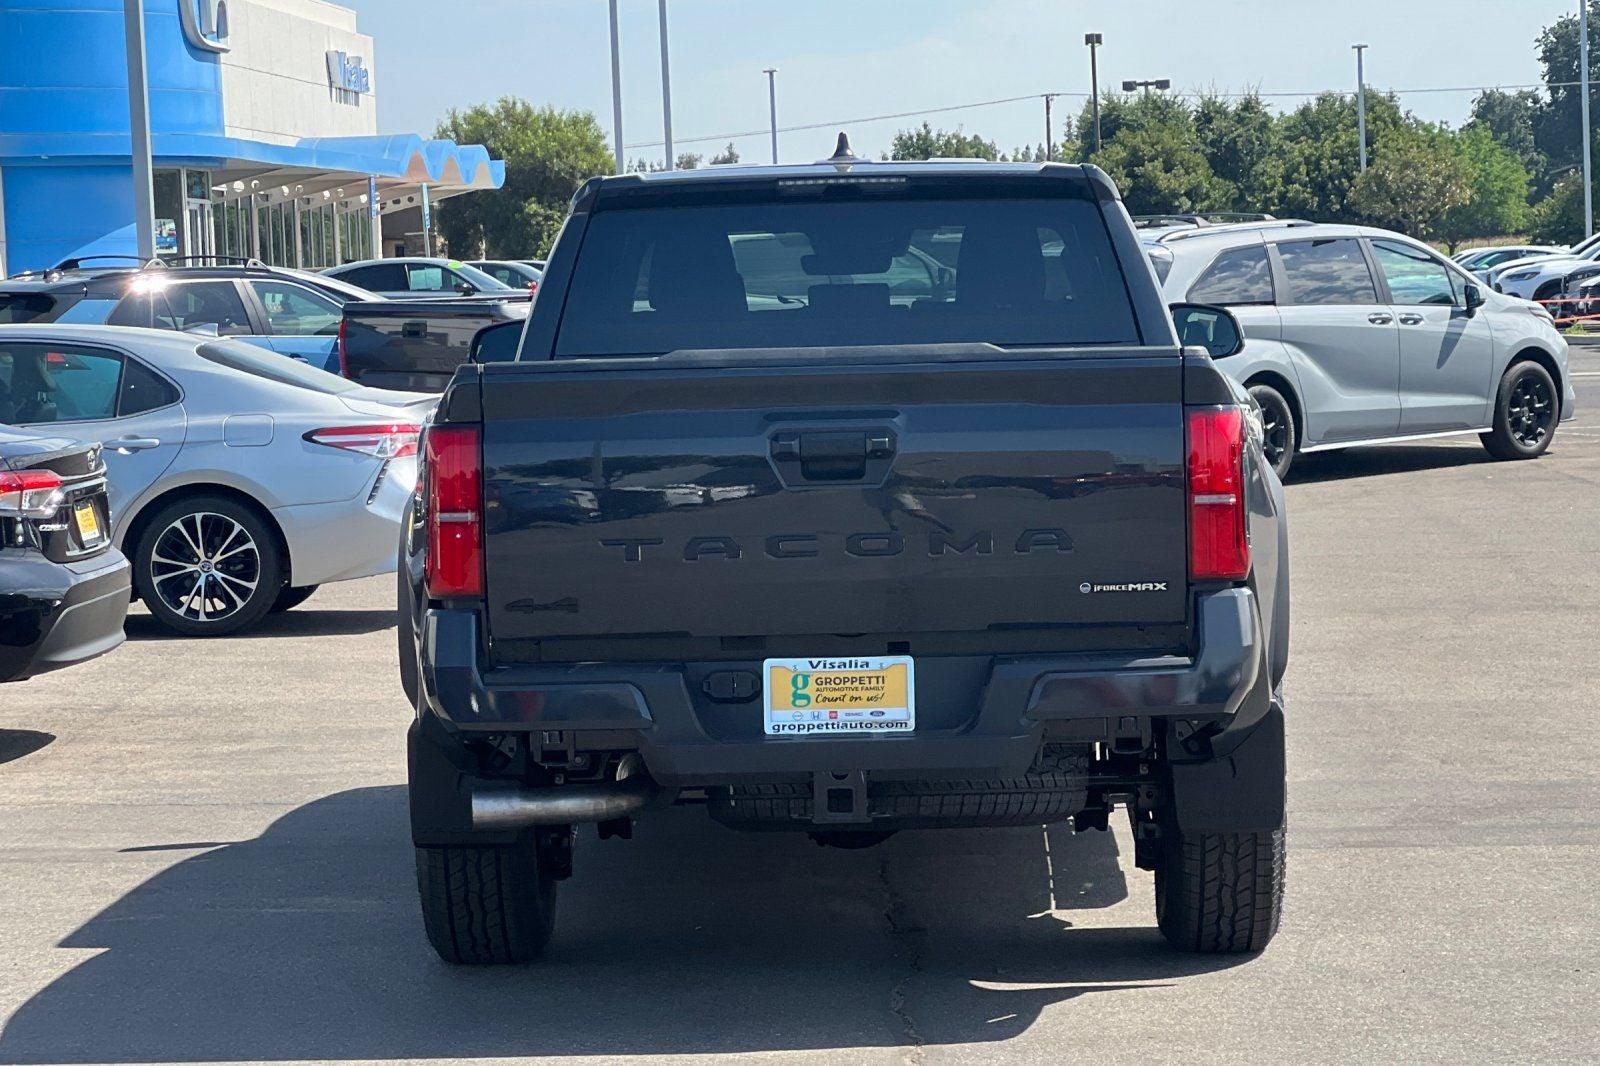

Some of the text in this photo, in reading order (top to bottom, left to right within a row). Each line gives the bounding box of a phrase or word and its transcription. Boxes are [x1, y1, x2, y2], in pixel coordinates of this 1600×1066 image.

[599, 528, 1074, 562] TACOMA
[808, 659, 870, 669] Visalia
[815, 675, 885, 686] GROPPETTI
[815, 693, 847, 704] Count
[866, 692, 885, 702] us!
[772, 720, 908, 733] groppettiauto.com
